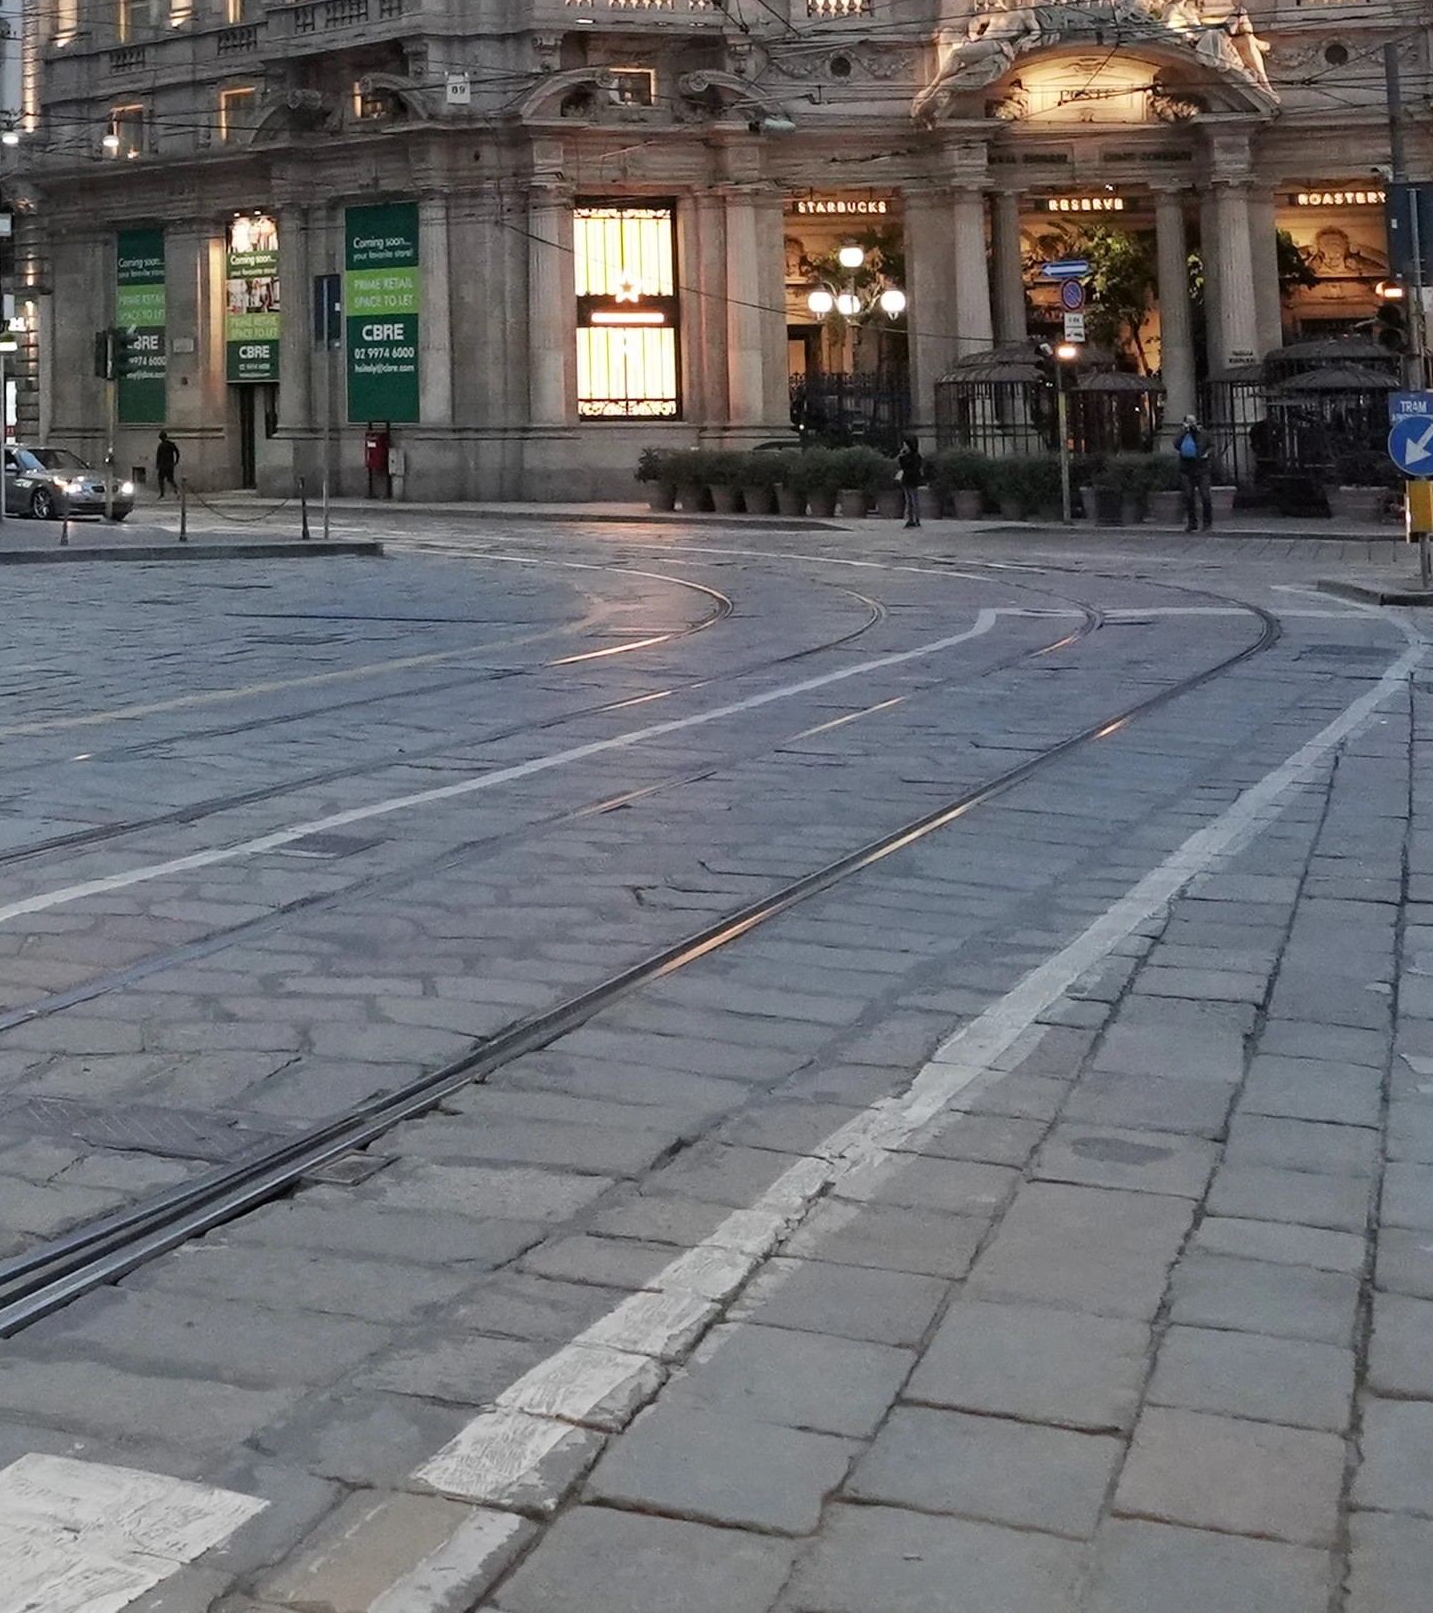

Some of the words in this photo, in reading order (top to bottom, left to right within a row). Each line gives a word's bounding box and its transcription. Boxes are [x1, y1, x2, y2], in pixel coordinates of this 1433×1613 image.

[798, 201, 886, 213] STARBUCKS
[1048, 198, 1124, 211] RESERVE
[1298, 191, 1386, 205] ROASTERY
[353, 237, 384, 249] Coming
[118, 257, 143, 268] Coming
[230, 255, 255, 266] Coming
[353, 252, 367, 261] your
[354, 279, 381, 290] PRIME
[384, 277, 413, 289] RETAIL
[354, 296, 381, 308] SPACE
[384, 295, 397, 306] TO
[398, 294, 414, 306] LET
[362, 324, 404, 341] CBRE
[239, 345, 270, 359] CBRE
[354, 348, 366, 359] 02
[367, 347, 390, 359] 9974
[391, 347, 414, 358] 6000
[1400, 400, 1428, 413] TRAM
